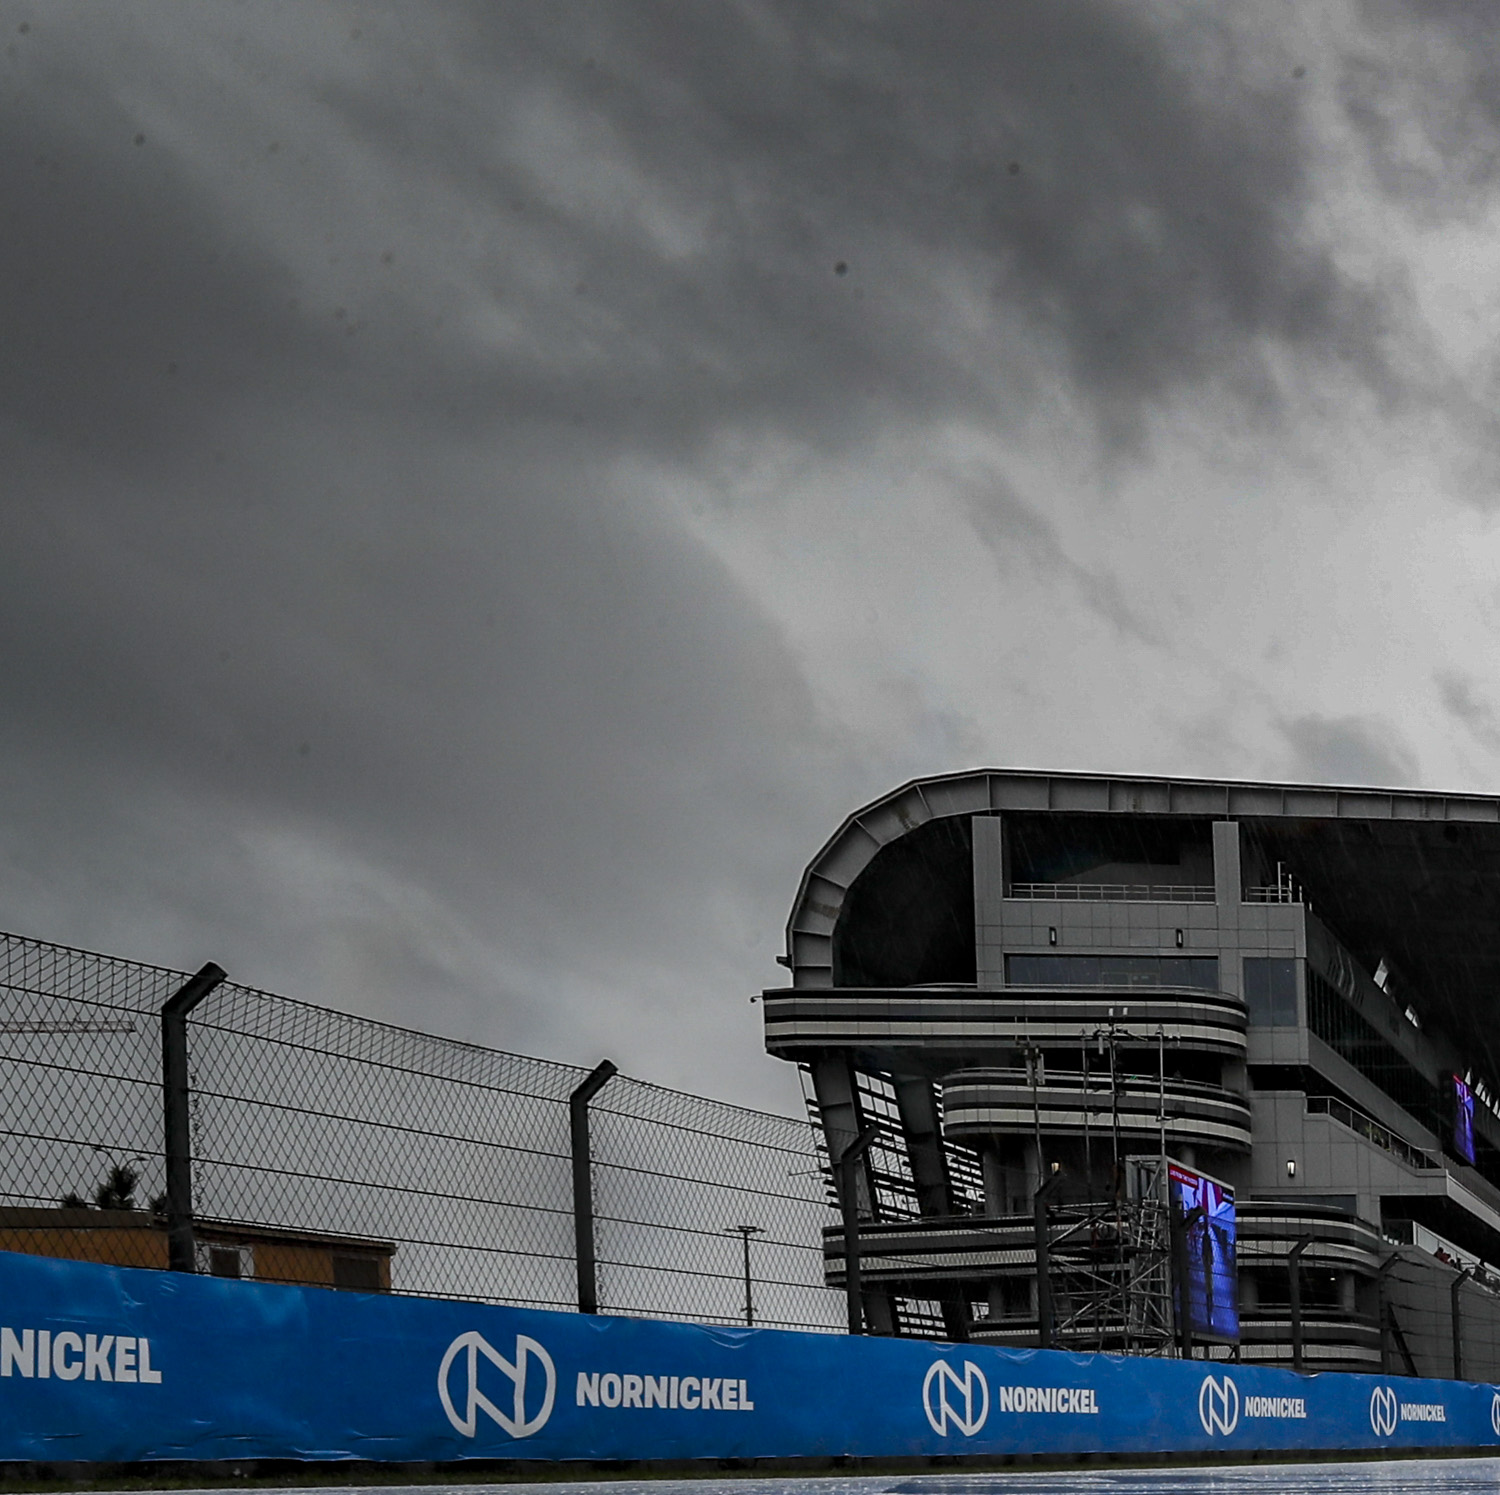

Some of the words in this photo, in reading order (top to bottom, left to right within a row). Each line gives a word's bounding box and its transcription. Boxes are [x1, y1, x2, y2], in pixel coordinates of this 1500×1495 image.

[0, 1326, 163, 1384] NICKEL
[575, 1371, 755, 1412] NORNICKEL
[1000, 1386, 1099, 1415] NORNICKEL
[1244, 1396, 1307, 1419] NORNICKEL
[1400, 1403, 1446, 1422] NORNICKEL
